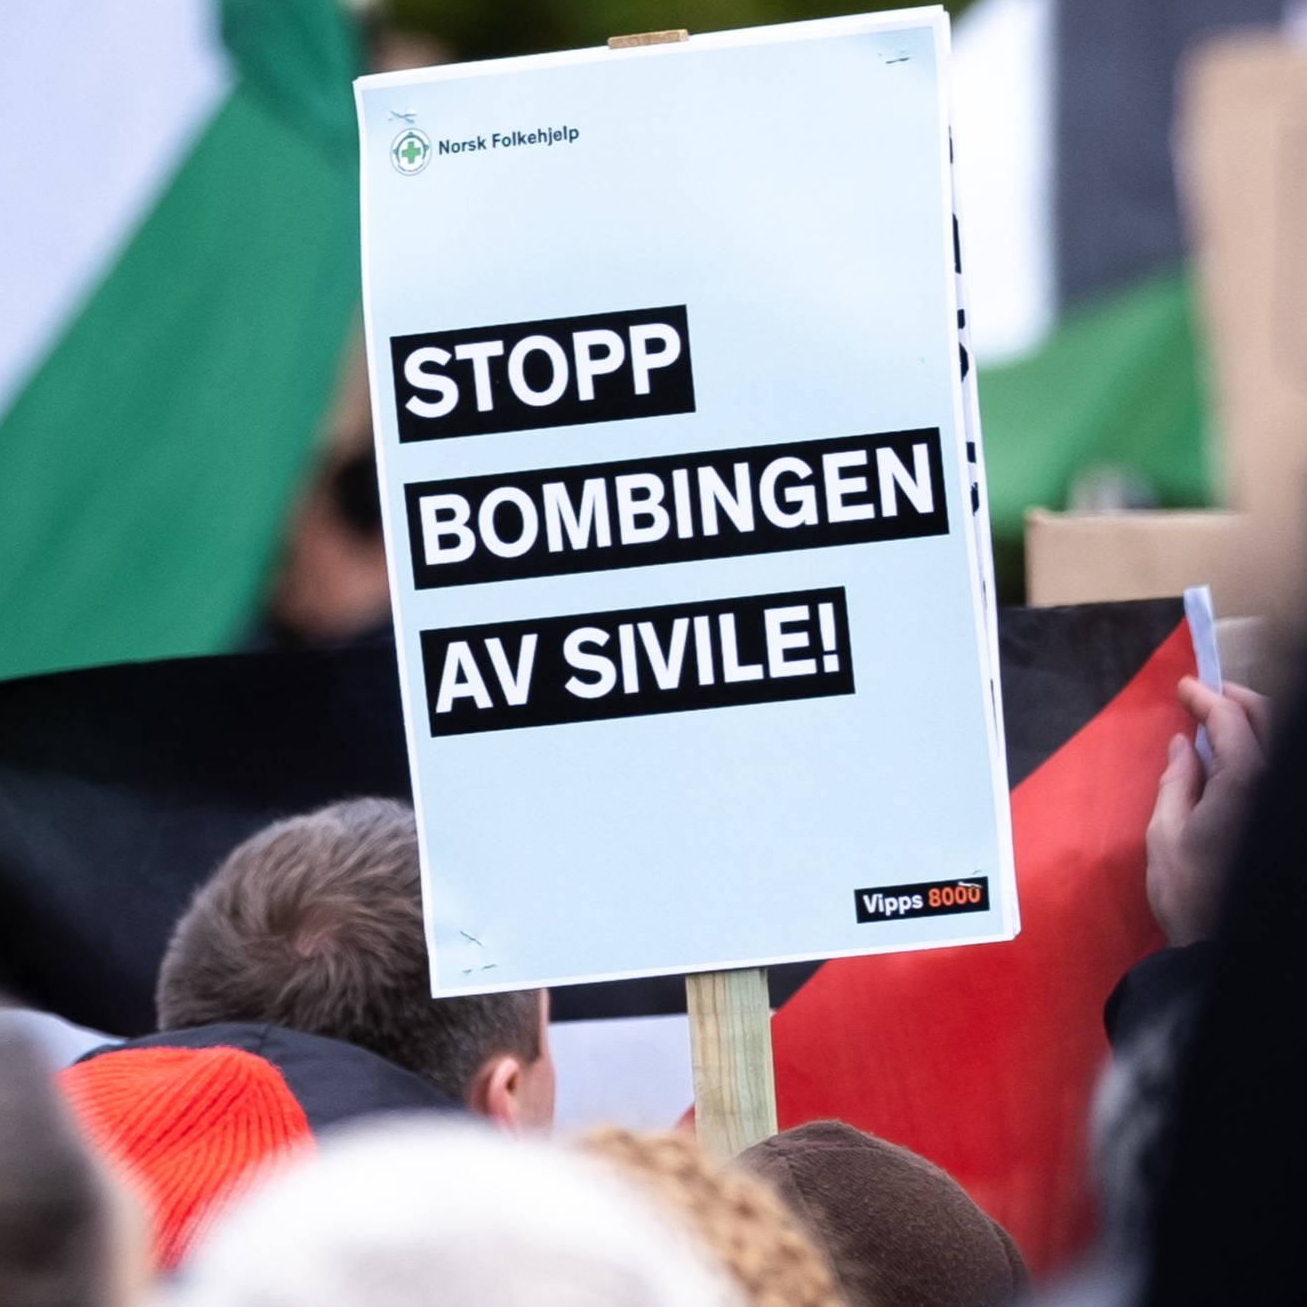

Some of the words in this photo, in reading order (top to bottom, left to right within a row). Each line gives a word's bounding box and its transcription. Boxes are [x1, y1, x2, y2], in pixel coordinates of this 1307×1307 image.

[438, 135, 488, 156] Norsk
[492, 125, 580, 147] Folkehjelp
[404, 323, 681, 418] STOPP
[419, 443, 934, 566] BOMBINGEN
[435, 633, 538, 714] AV
[563, 602, 840, 699] SIVILE!
[862, 892, 924, 917] Vipps
[928, 885, 982, 908] 8000
